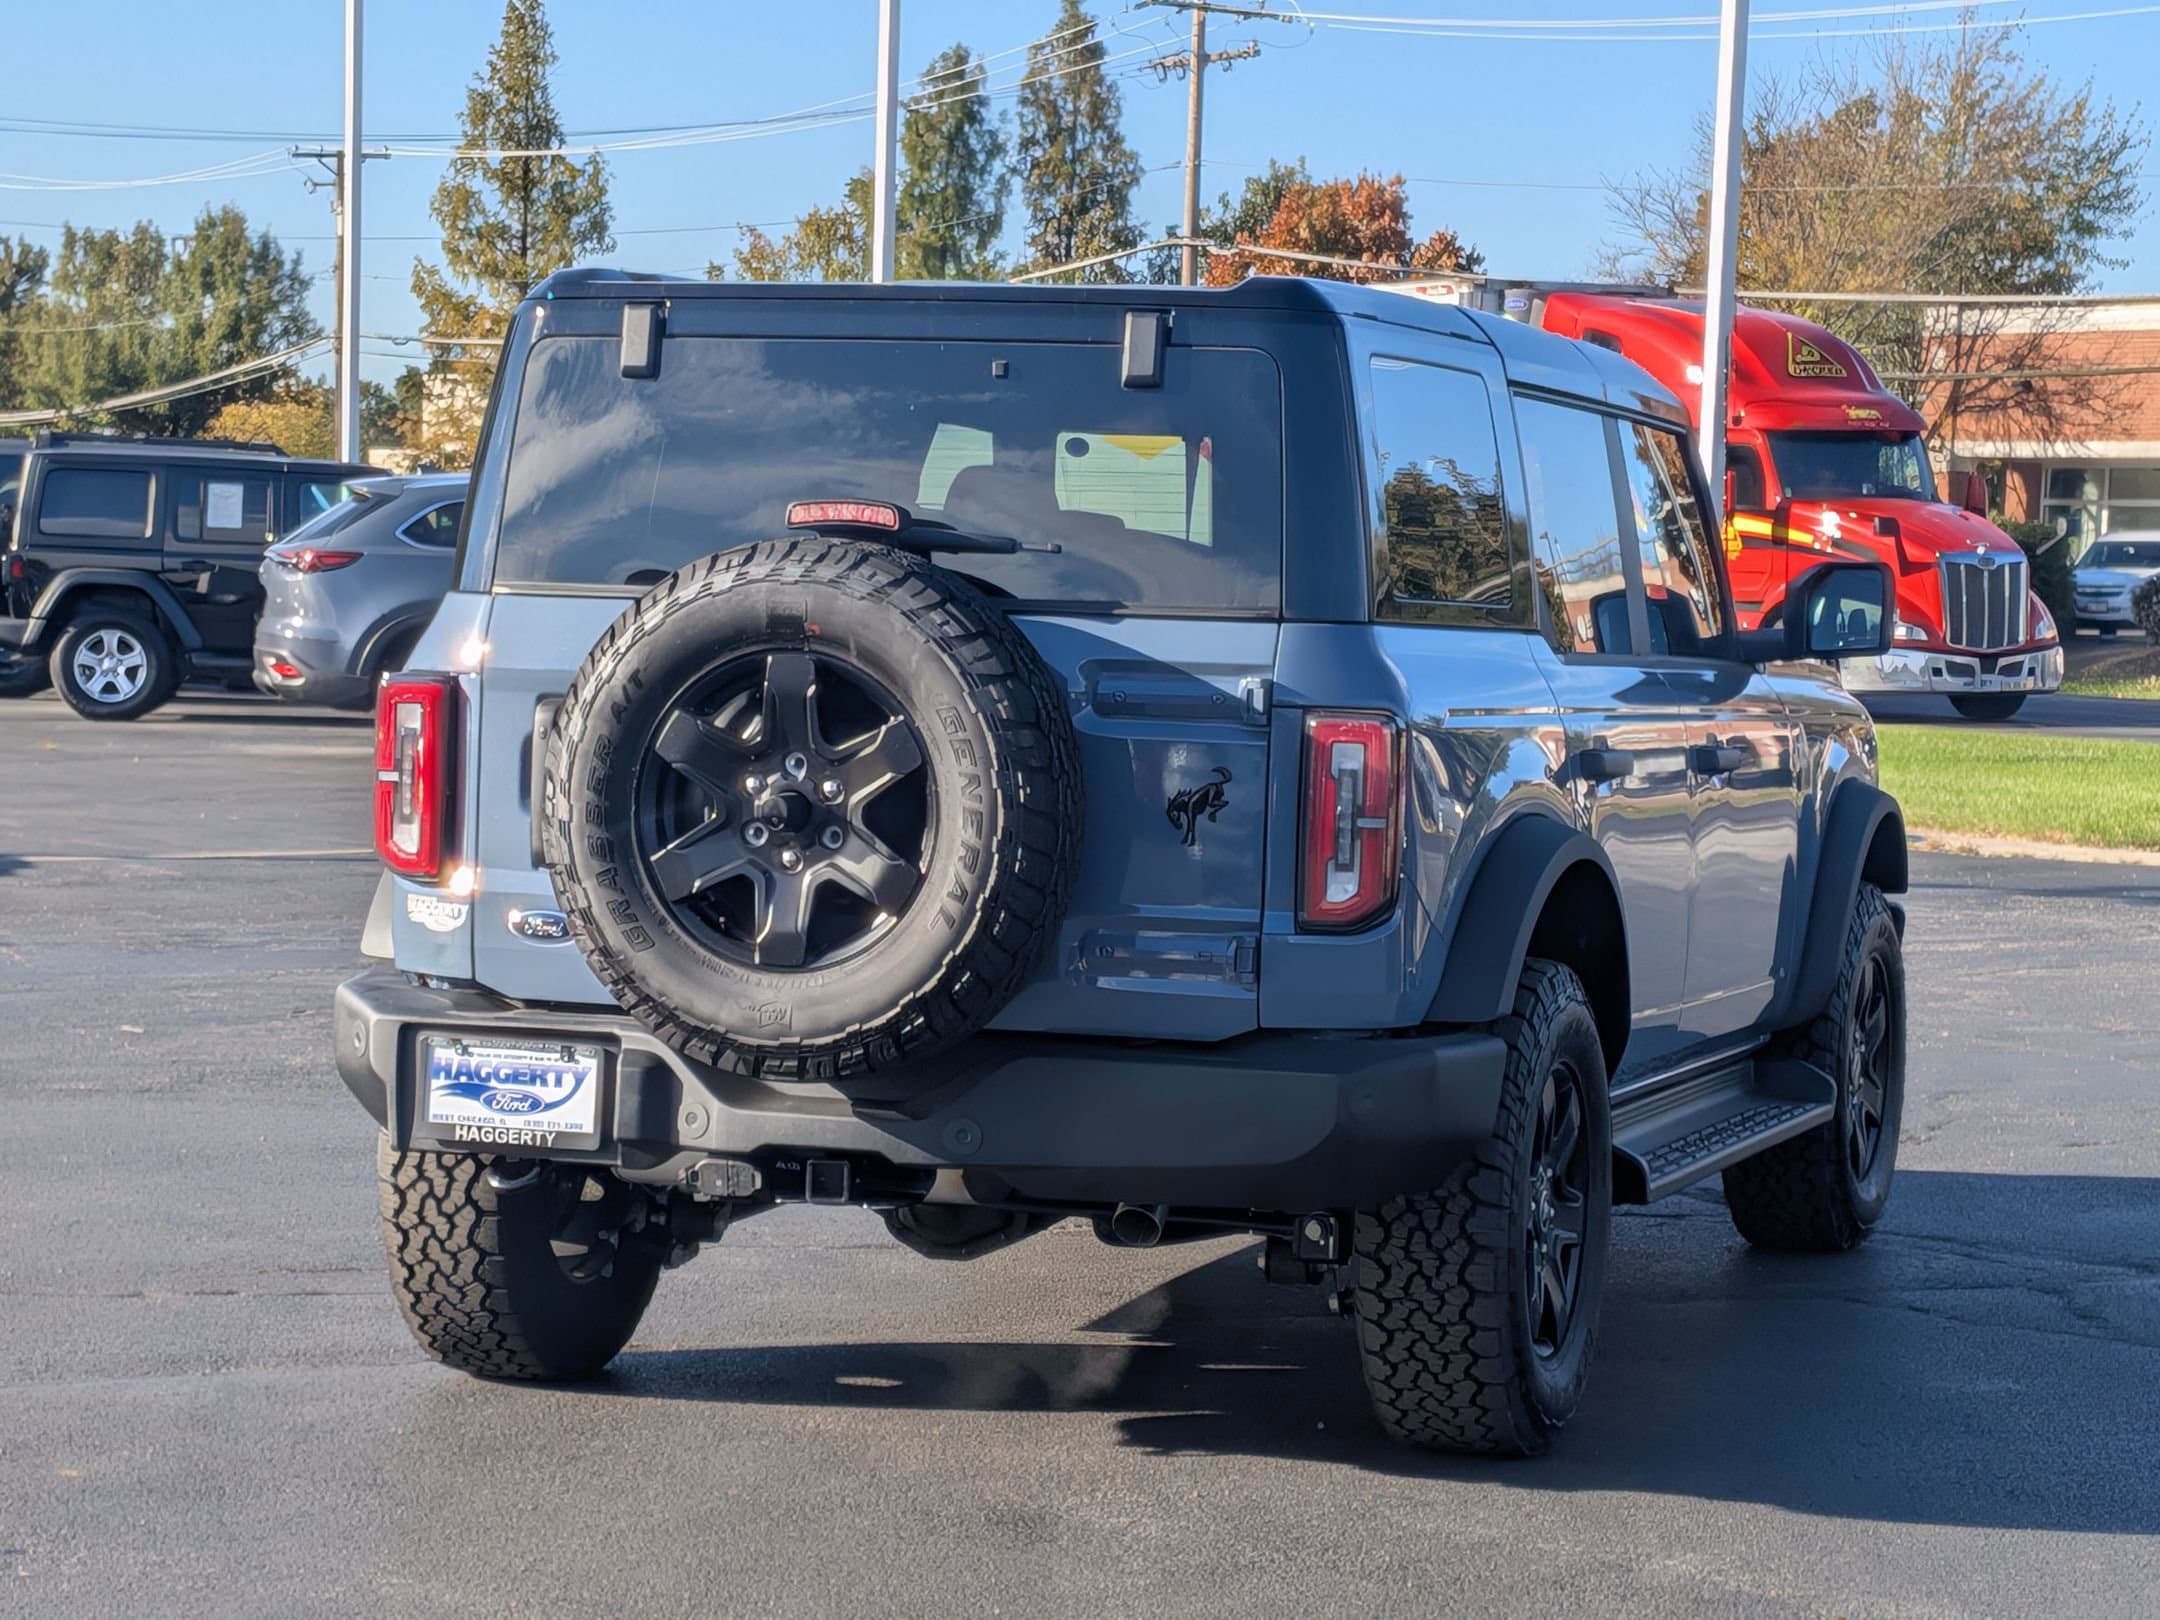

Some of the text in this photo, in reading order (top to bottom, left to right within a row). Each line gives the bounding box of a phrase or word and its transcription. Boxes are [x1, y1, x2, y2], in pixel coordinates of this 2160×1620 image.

[928, 705, 984, 931] GENERAL
[585, 733, 655, 952] GRABBER
[523, 916, 564, 936] Ford
[431, 1057, 592, 1090] HAGGERTY
[491, 1091, 532, 1113] Ford
[455, 1124, 557, 1147] HAGGERTY
